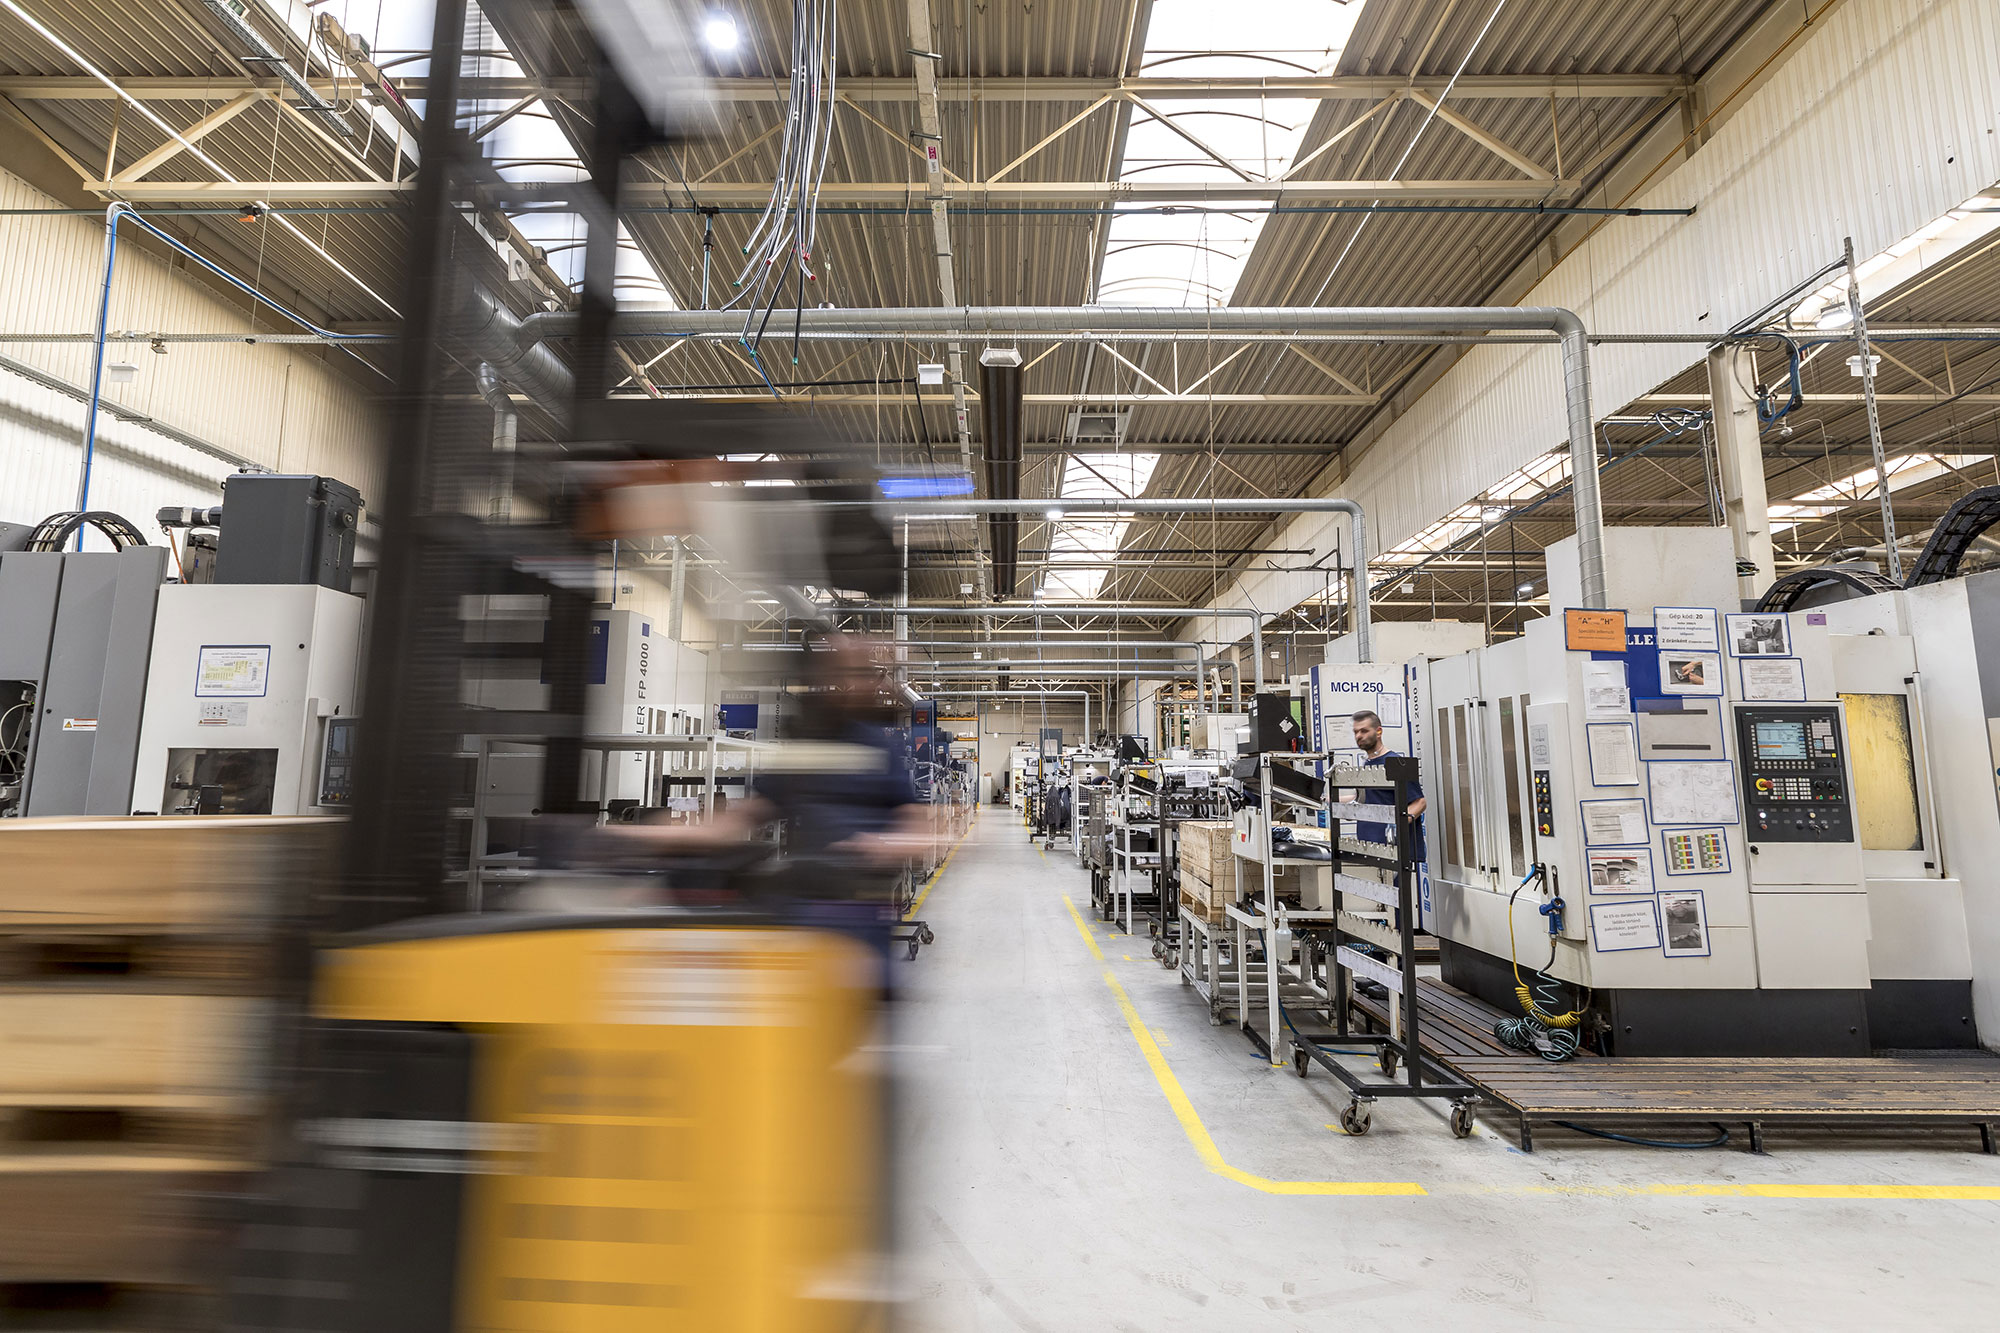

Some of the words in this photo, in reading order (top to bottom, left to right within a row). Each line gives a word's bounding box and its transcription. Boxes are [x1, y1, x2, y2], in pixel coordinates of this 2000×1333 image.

[640, 643, 649, 676] 4000
[638, 680, 647, 699] FP
[1331, 681, 1359, 693] MCH
[1362, 682, 1384, 693] 250
[634, 706, 645, 762] HLER
[1415, 724, 1421, 734] H
